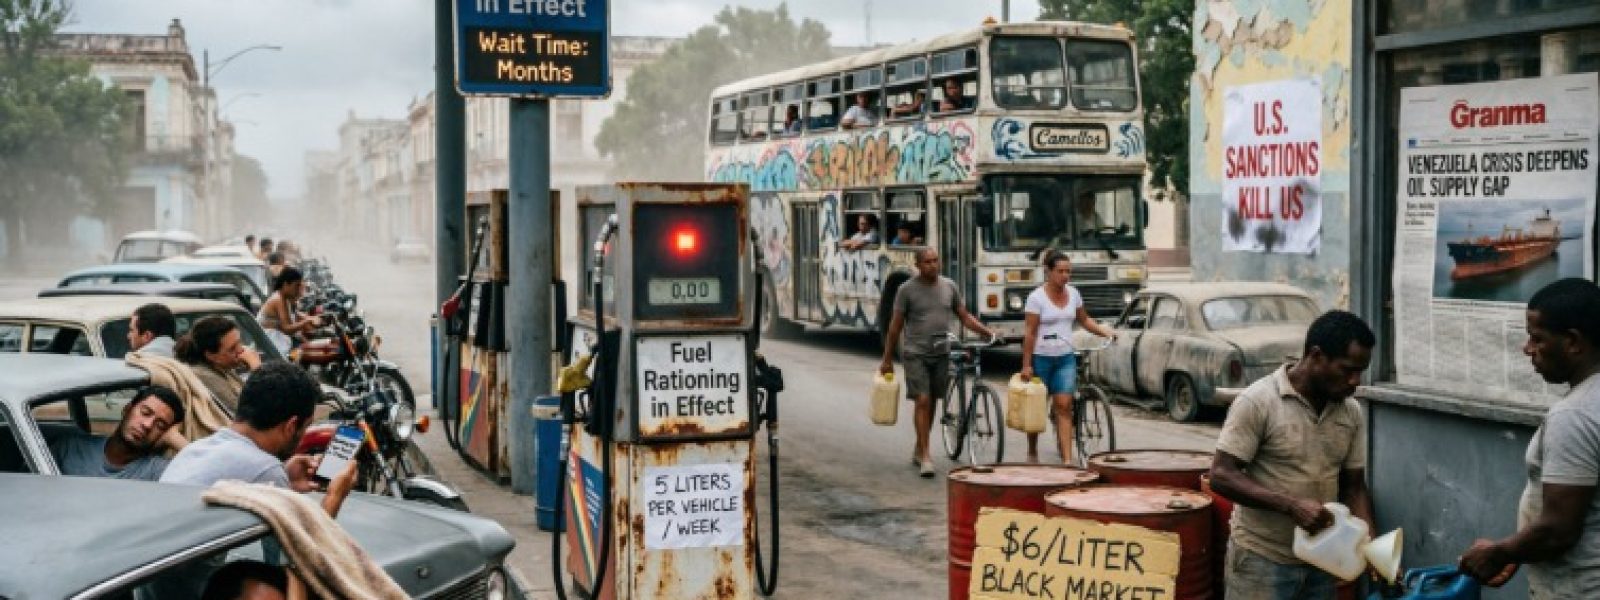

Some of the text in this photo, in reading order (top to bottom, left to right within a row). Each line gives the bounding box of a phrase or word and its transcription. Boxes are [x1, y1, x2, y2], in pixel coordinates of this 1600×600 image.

[478, 31, 589, 56] Wait Time:
[498, 58, 573, 82] Months
[1254, 99, 1289, 136] U.S.
[1450, 100, 1546, 129] Granma
[1037, 128, 1103, 147] Camellos
[1226, 141, 1319, 178] SANCTIONS
[1408, 148, 1589, 174] VENEZUELA CRISIS DEEPENS
[1407, 175, 1510, 198] OIL SUPPLY GAP
[1238, 185, 1304, 221] KILL US
[672, 281, 710, 299] 0.00
[671, 341, 712, 363] Fuel
[644, 369, 740, 393] Rationing
[651, 395, 735, 417] in Effect
[655, 472, 731, 495] 5 LITERS
[648, 496, 738, 516] PER VEHICLE
[677, 518, 721, 535] WEEK
[981, 563, 1166, 600] BLACK MARKET
